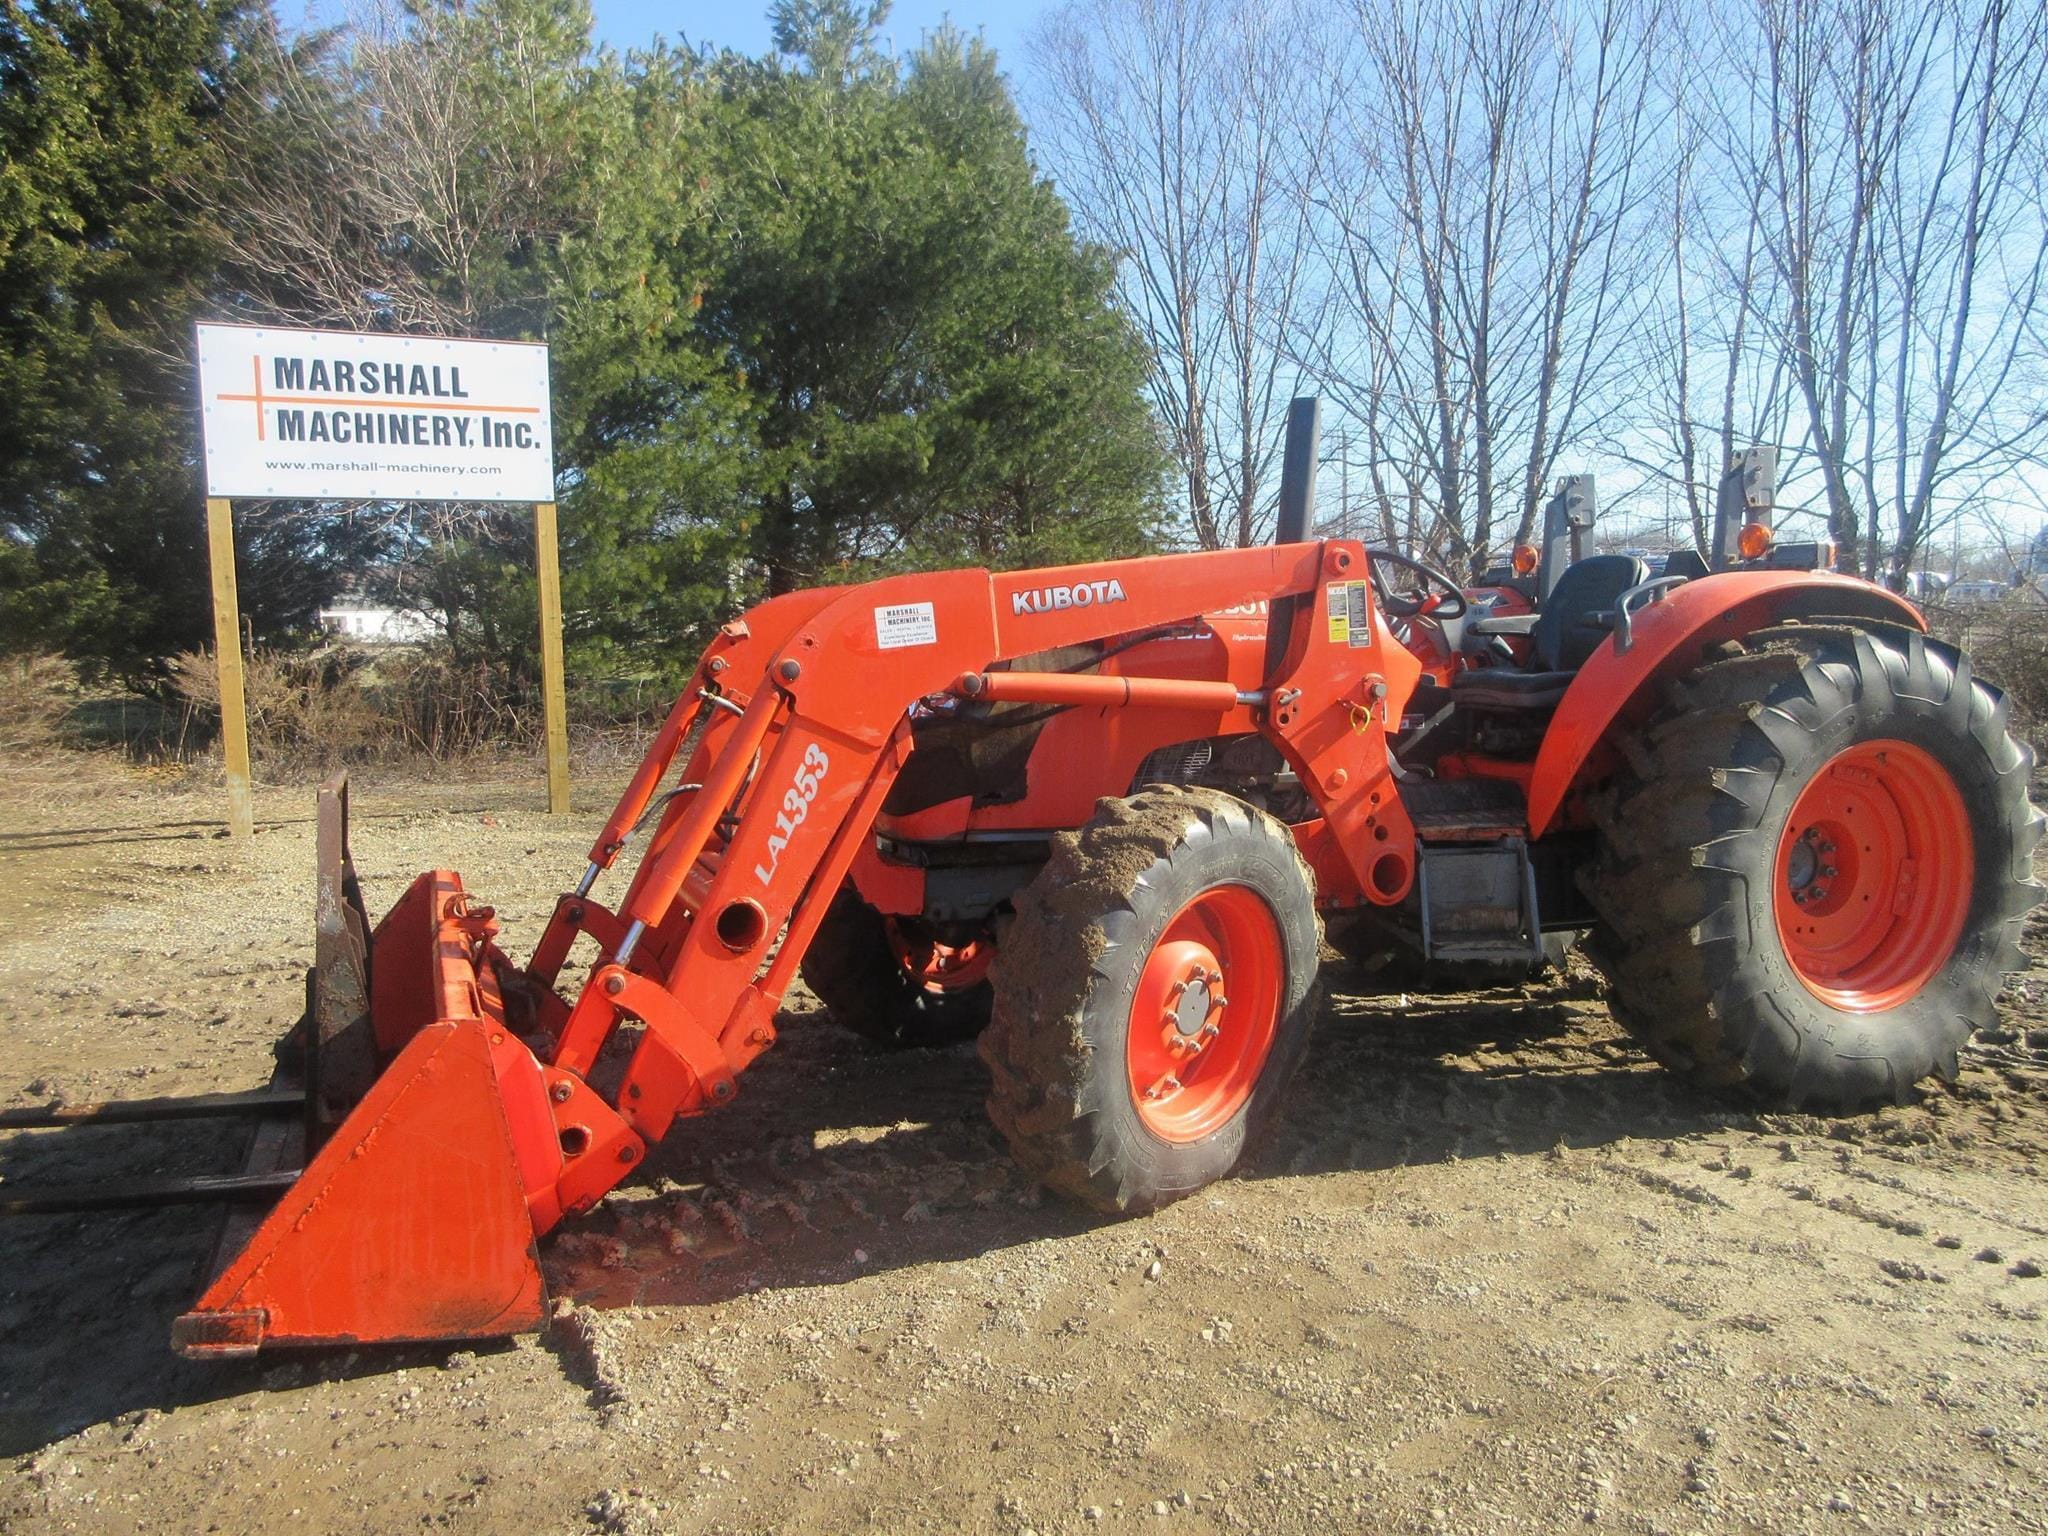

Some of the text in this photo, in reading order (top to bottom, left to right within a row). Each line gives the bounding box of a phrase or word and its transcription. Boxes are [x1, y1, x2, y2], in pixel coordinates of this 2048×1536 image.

[274, 357, 468, 398] MARSHALL
[277, 409, 541, 449] MACHINERY, Inc.
[265, 460, 502, 475] www.marshall-machinery.com
[886, 608, 919, 617] MARSHALL
[1012, 579, 1127, 615] KUBOTA
[754, 743, 829, 886] LA1353
